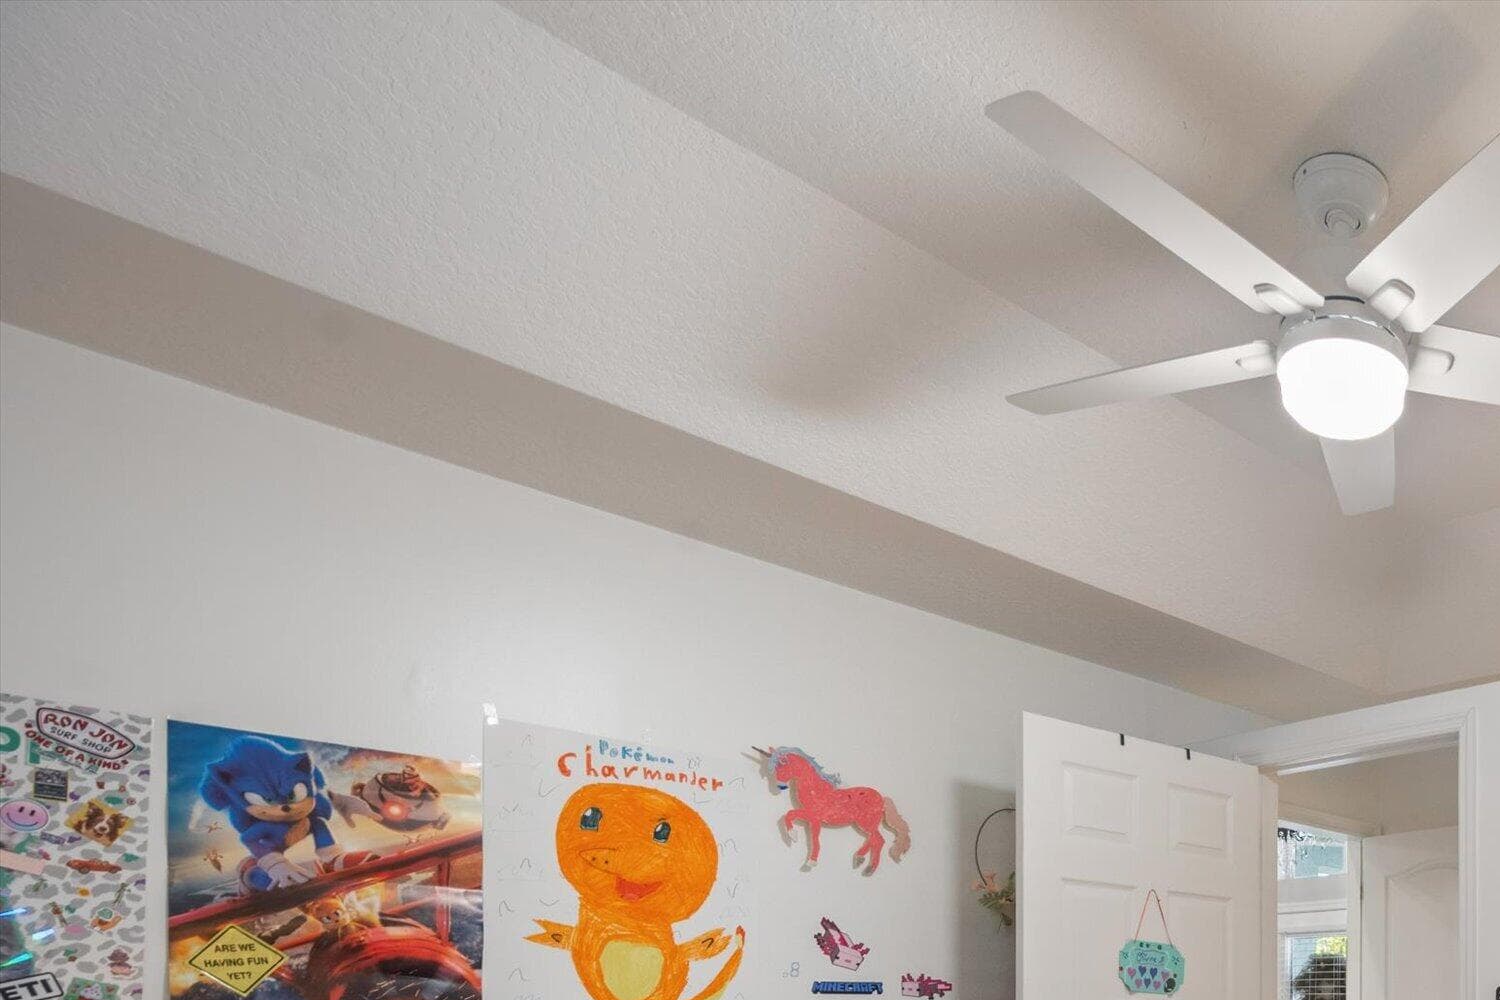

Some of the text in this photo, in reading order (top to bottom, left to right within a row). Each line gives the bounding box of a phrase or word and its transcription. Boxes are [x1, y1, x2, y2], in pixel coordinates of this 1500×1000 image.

[43, 713, 129, 750] RON JON
[50, 726, 112, 753] SURF SHOP
[55, 745, 75, 757] OF
[76, 754, 85, 762] A
[214, 943, 256, 953] ARE WE
[203, 956, 268, 968] HAVING FUN
[226, 971, 252, 980] YET?
[812, 981, 883, 994] MINECRAFT
